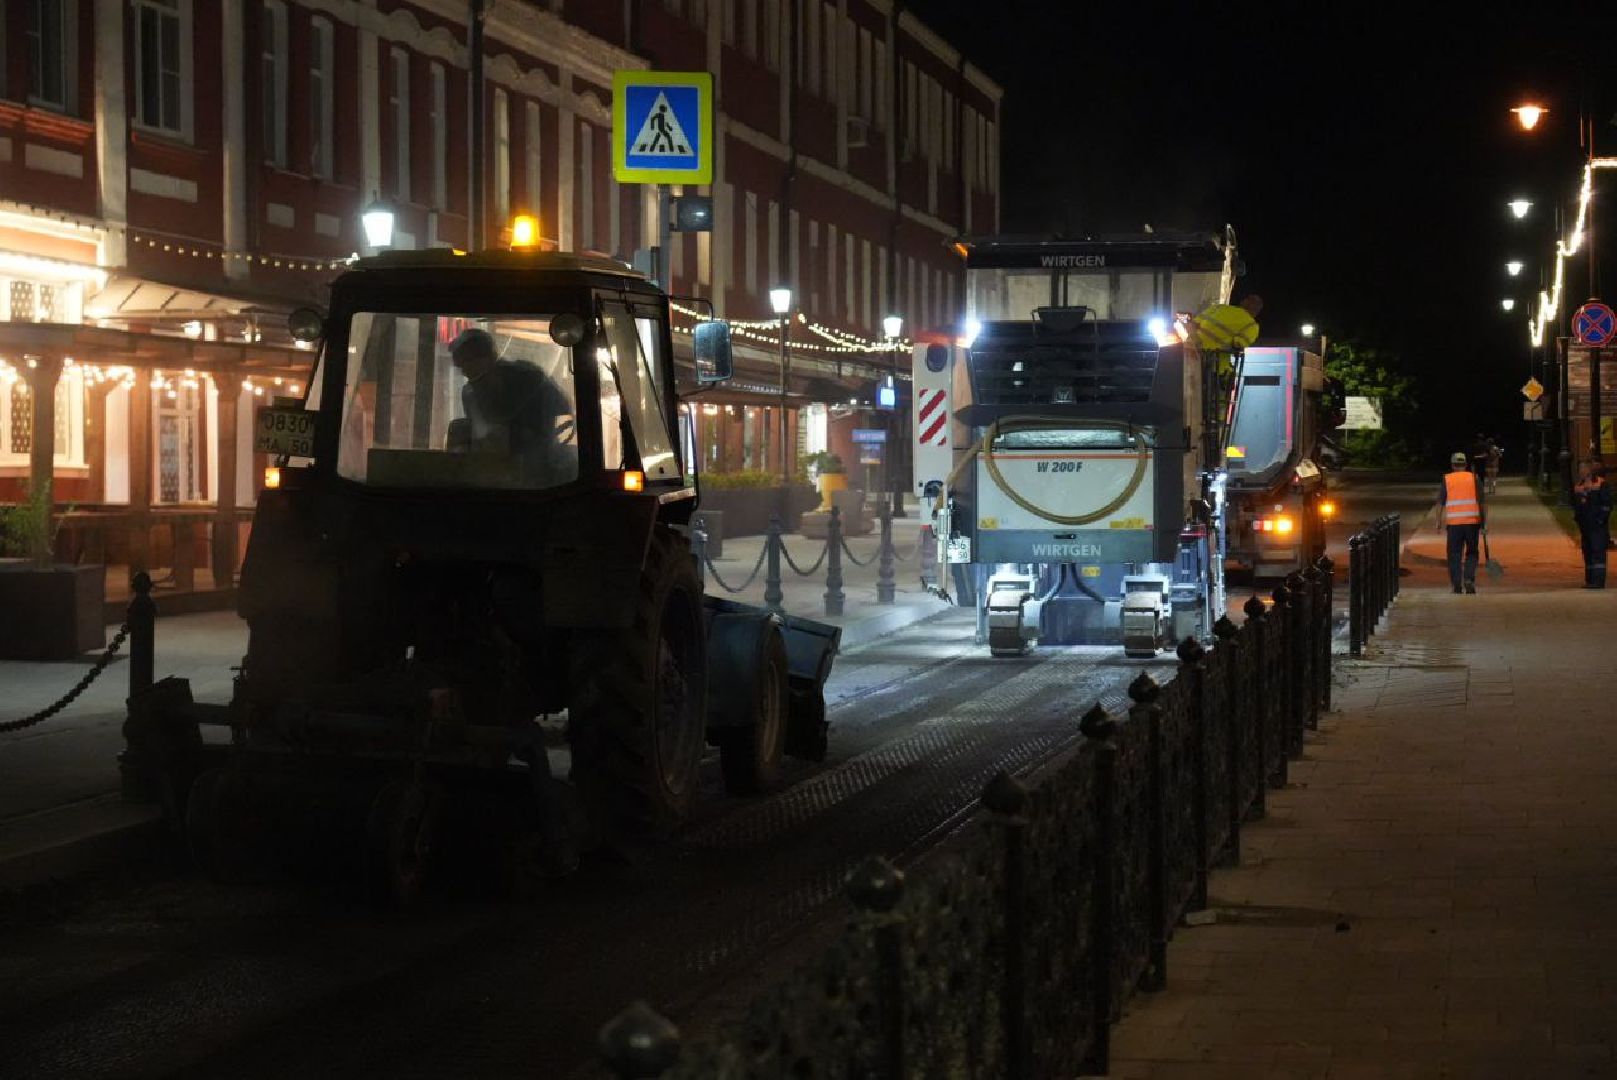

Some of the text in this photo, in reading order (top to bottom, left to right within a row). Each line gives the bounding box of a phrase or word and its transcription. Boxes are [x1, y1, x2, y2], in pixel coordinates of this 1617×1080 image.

[1041, 255, 1106, 267] WIRTGEN
[264, 414, 309, 433] 0830
[1037, 461, 1048, 473] W
[1032, 544, 1102, 555] WIRTGEN
